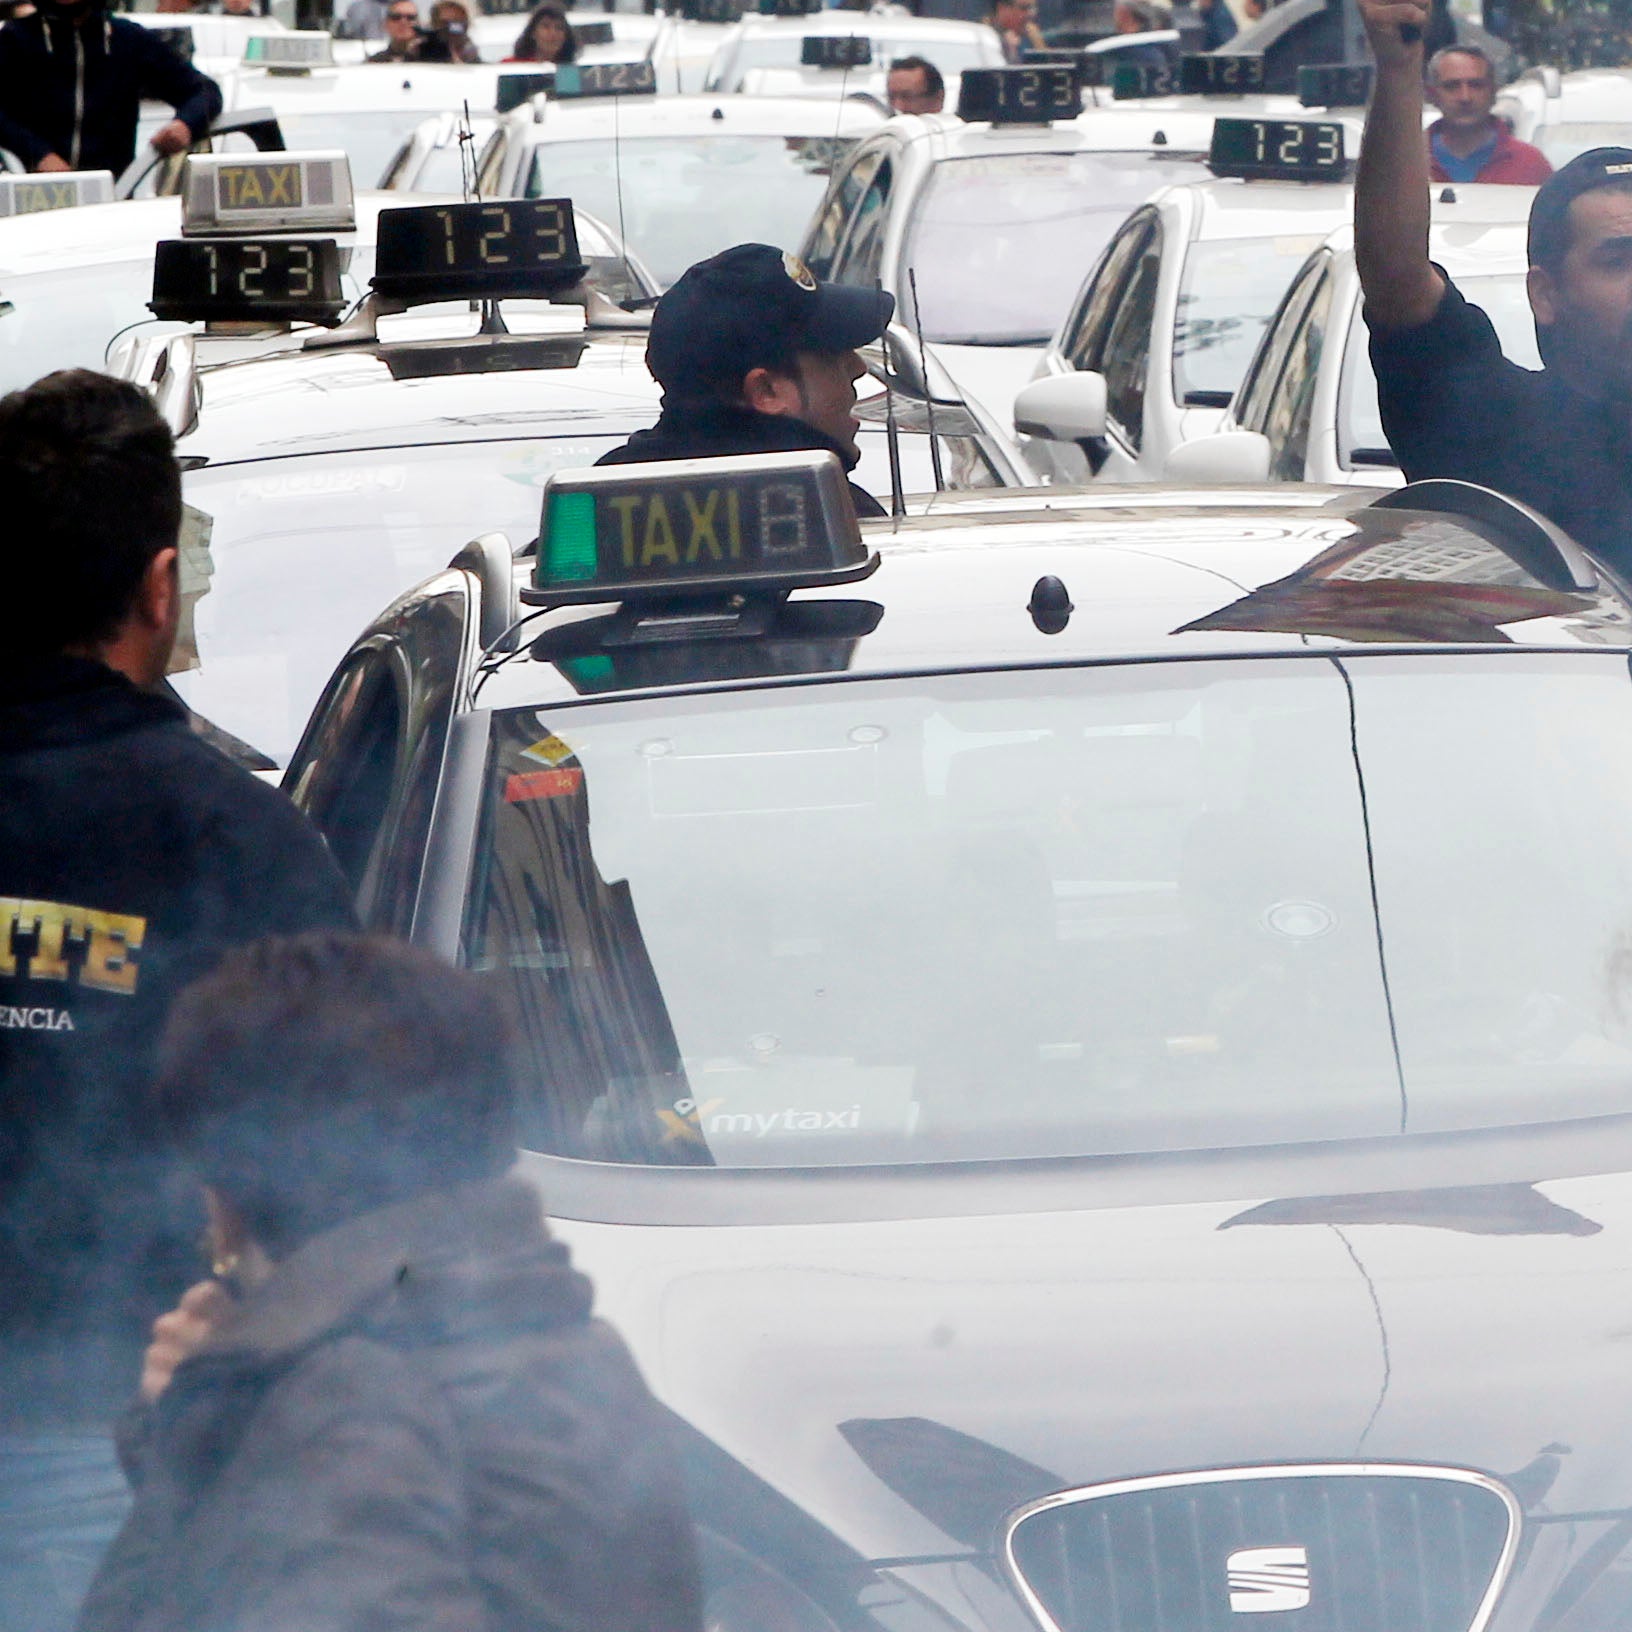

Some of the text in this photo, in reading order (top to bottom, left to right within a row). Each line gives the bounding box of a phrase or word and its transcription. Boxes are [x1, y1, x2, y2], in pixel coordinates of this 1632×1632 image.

[993, 71, 1073, 106] 123
[1254, 123, 1339, 165] 123
[16, 183, 77, 214] TAXI
[220, 167, 301, 208] TAXI
[437, 205, 568, 265] 123
[204, 245, 314, 296] 123
[610, 488, 741, 566] TAXI
[711, 1104, 862, 1137] mytaxi
